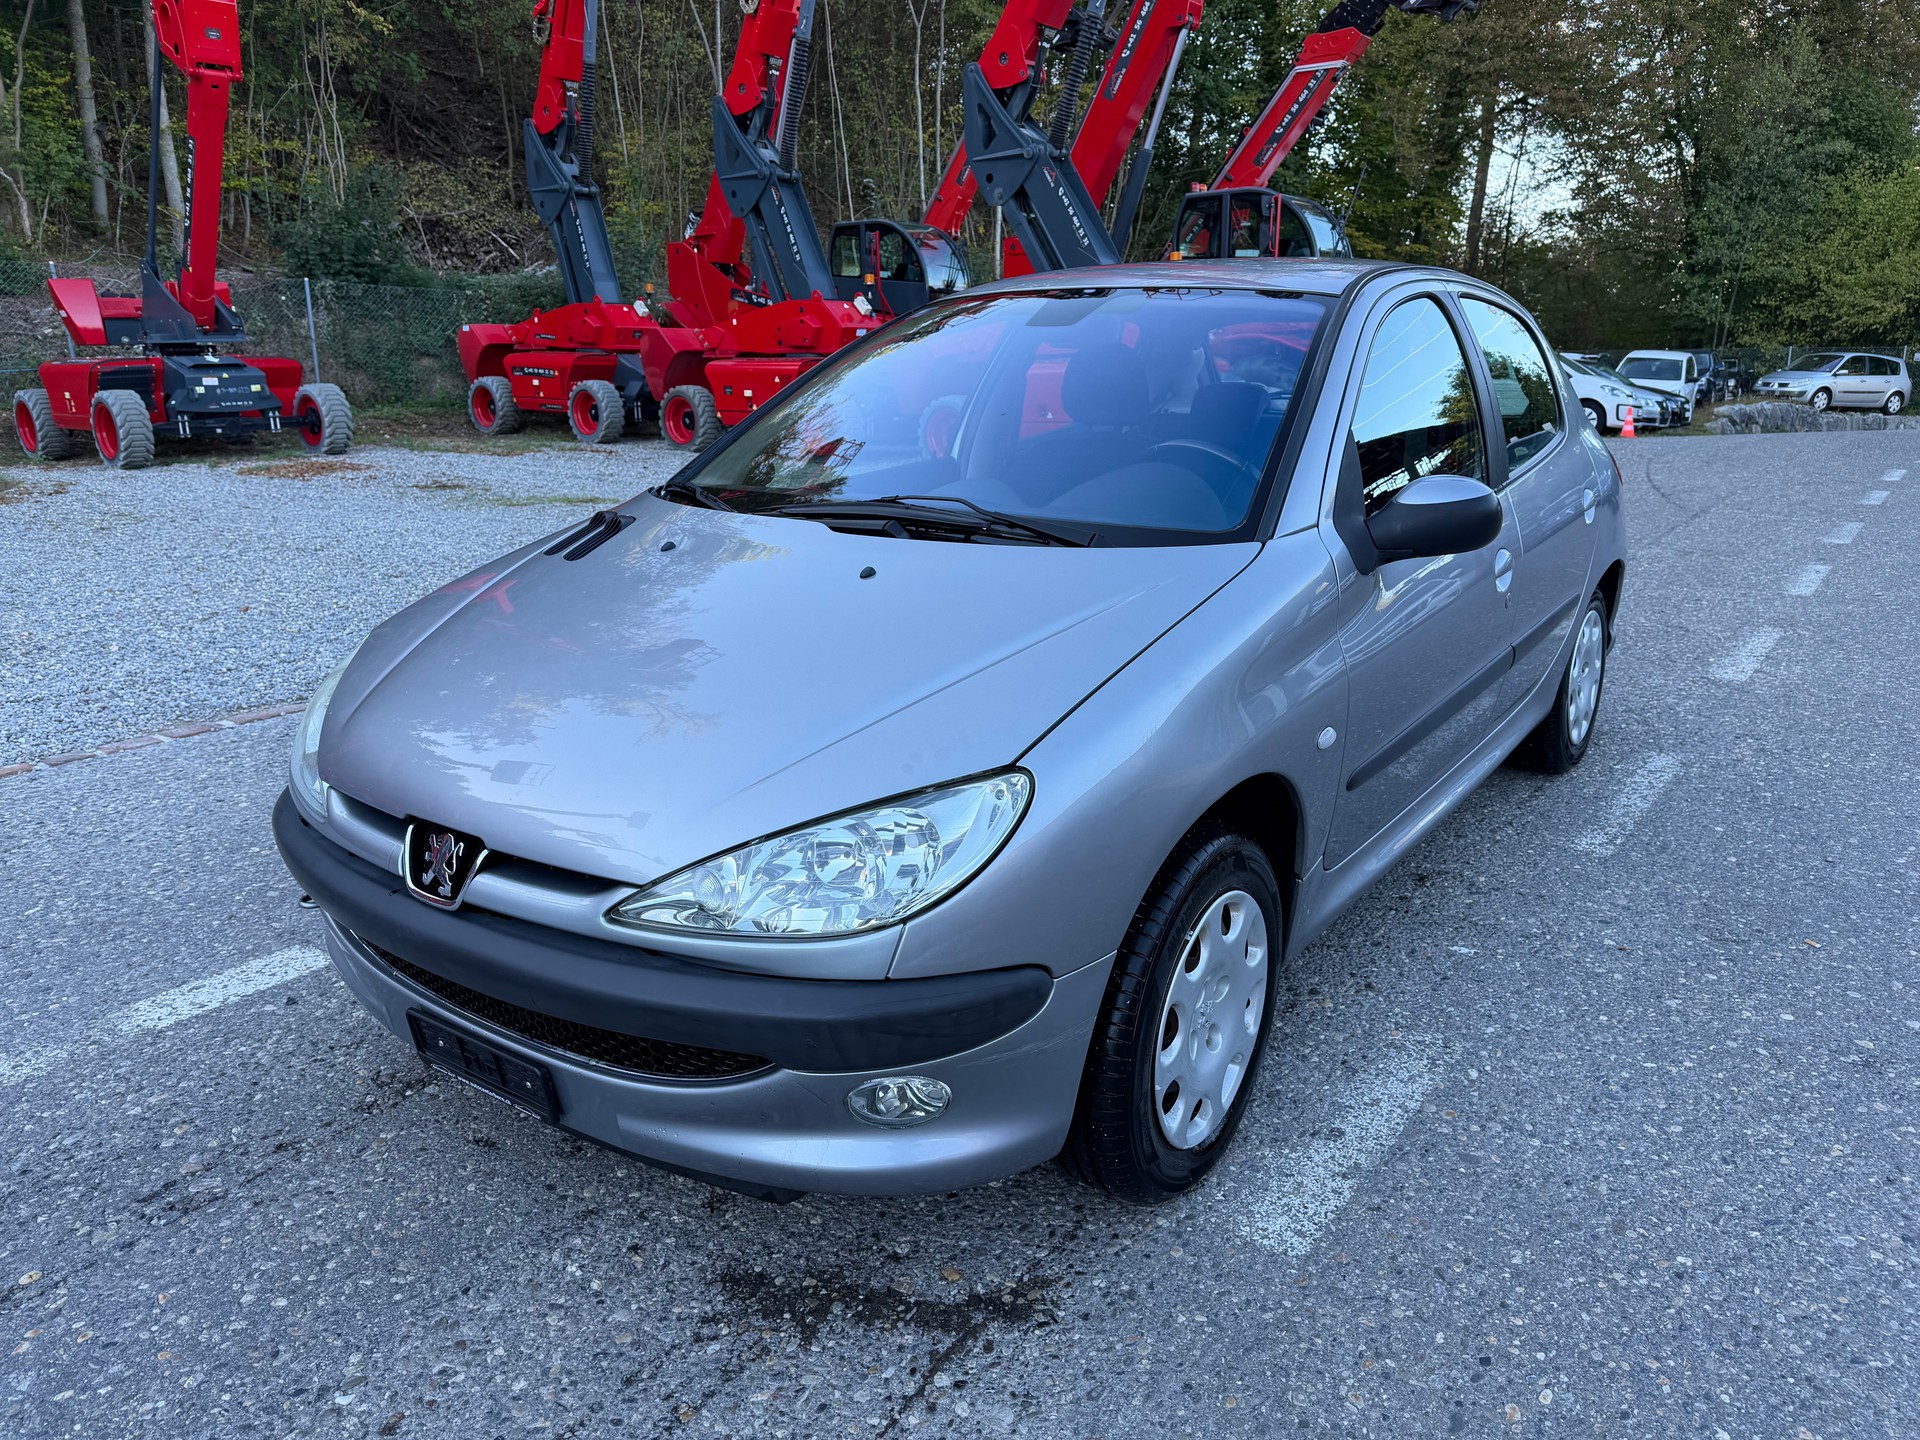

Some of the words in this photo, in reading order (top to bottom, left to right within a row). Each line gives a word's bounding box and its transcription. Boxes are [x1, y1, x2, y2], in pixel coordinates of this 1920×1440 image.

[1127, 33, 1137, 48] +41
[1134, 19, 1143, 30] 56
[1140, 1, 1150, 17] 464
[1282, 114, 1292, 126] +41
[1290, 103, 1299, 113] 56
[1298, 89, 1309, 102] 464
[1308, 79, 1317, 88] 31
